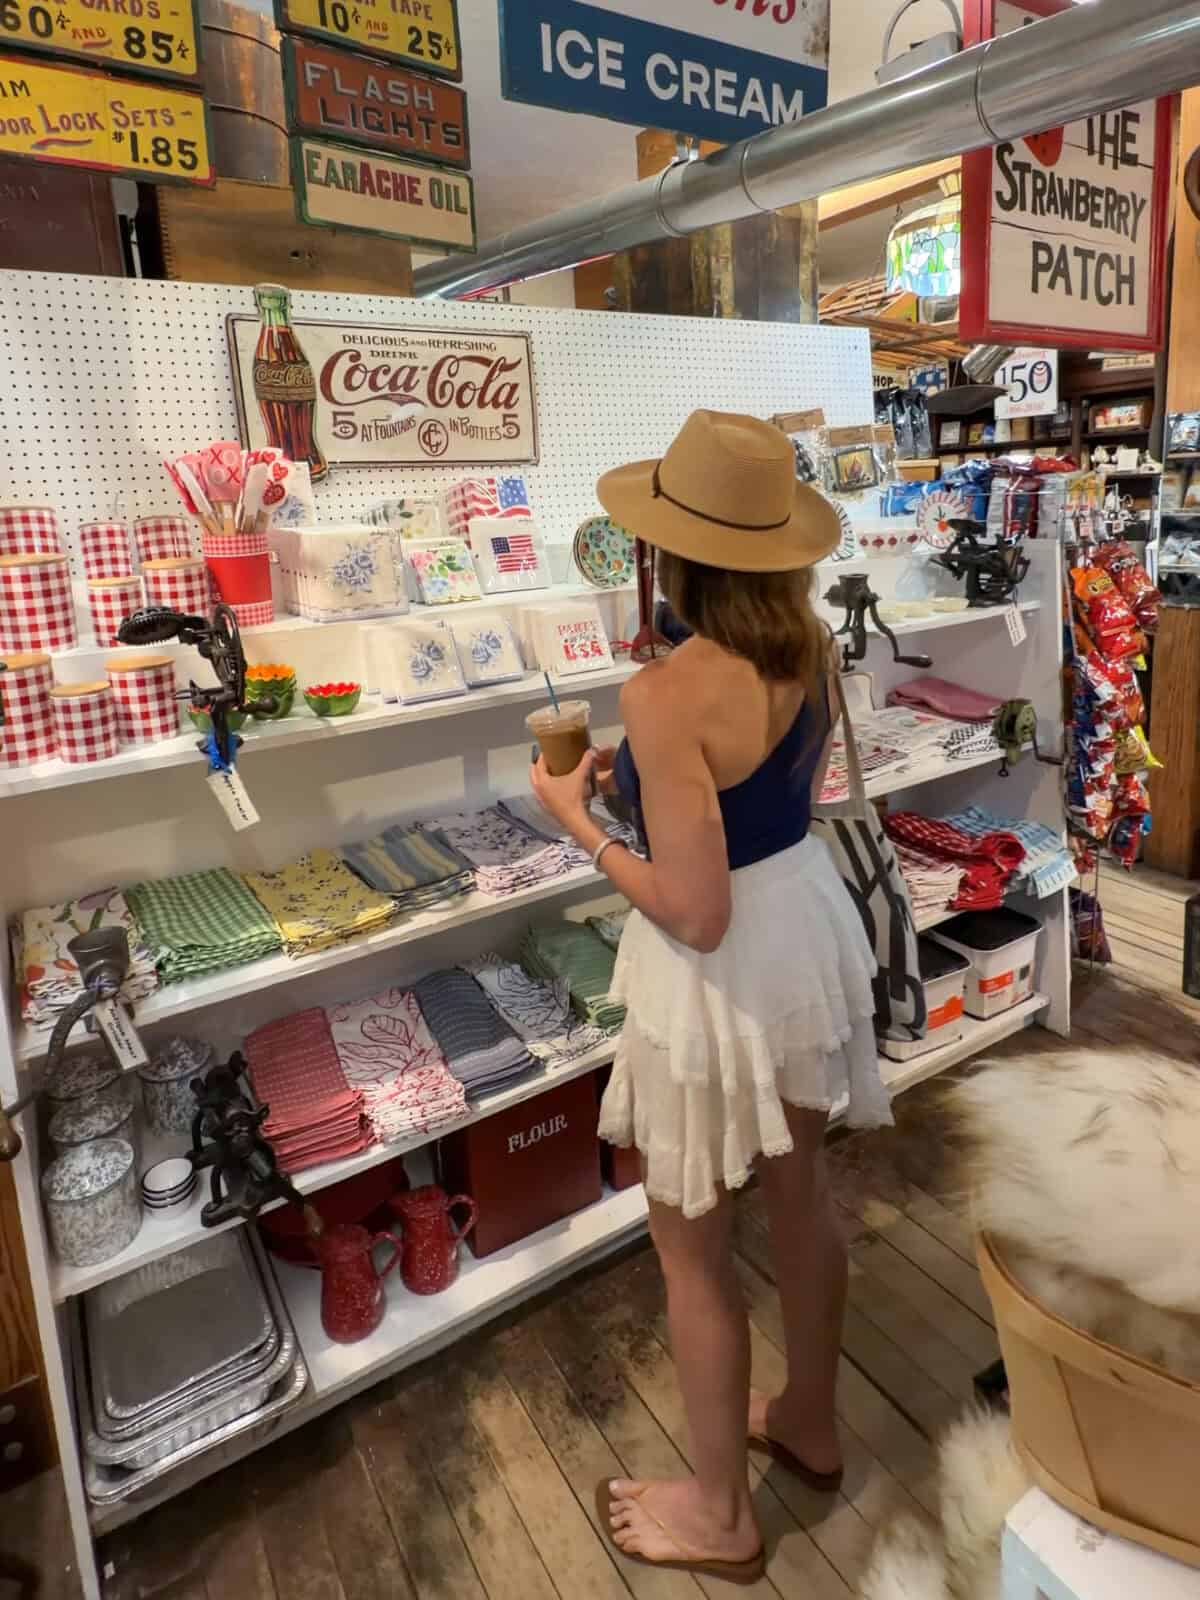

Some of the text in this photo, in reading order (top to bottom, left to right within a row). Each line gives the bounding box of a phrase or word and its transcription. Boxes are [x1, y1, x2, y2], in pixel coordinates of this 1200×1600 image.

[72, 27, 107, 40] AND
[304, 61, 435, 111] FLASH
[540, 22, 804, 125] ICE CREAM
[38, 104, 105, 133] LOCK
[110, 100, 175, 129] SETS
[318, 97, 462, 147] LIGHTS
[305, 149, 468, 215] EARACHE OIL
[995, 142, 1147, 243] STRAWBERRY
[1030, 240, 1136, 306] PATCH
[342, 333, 408, 347] DELICIOUS
[428, 338, 497, 352] REFRESHING
[370, 350, 419, 359] DRINK
[999, 360, 1052, 403] 150
[361, 423, 373, 442] AT
[457, 416, 502, 441] BOTTLES
[507, 1114, 568, 1154] FLOUR
